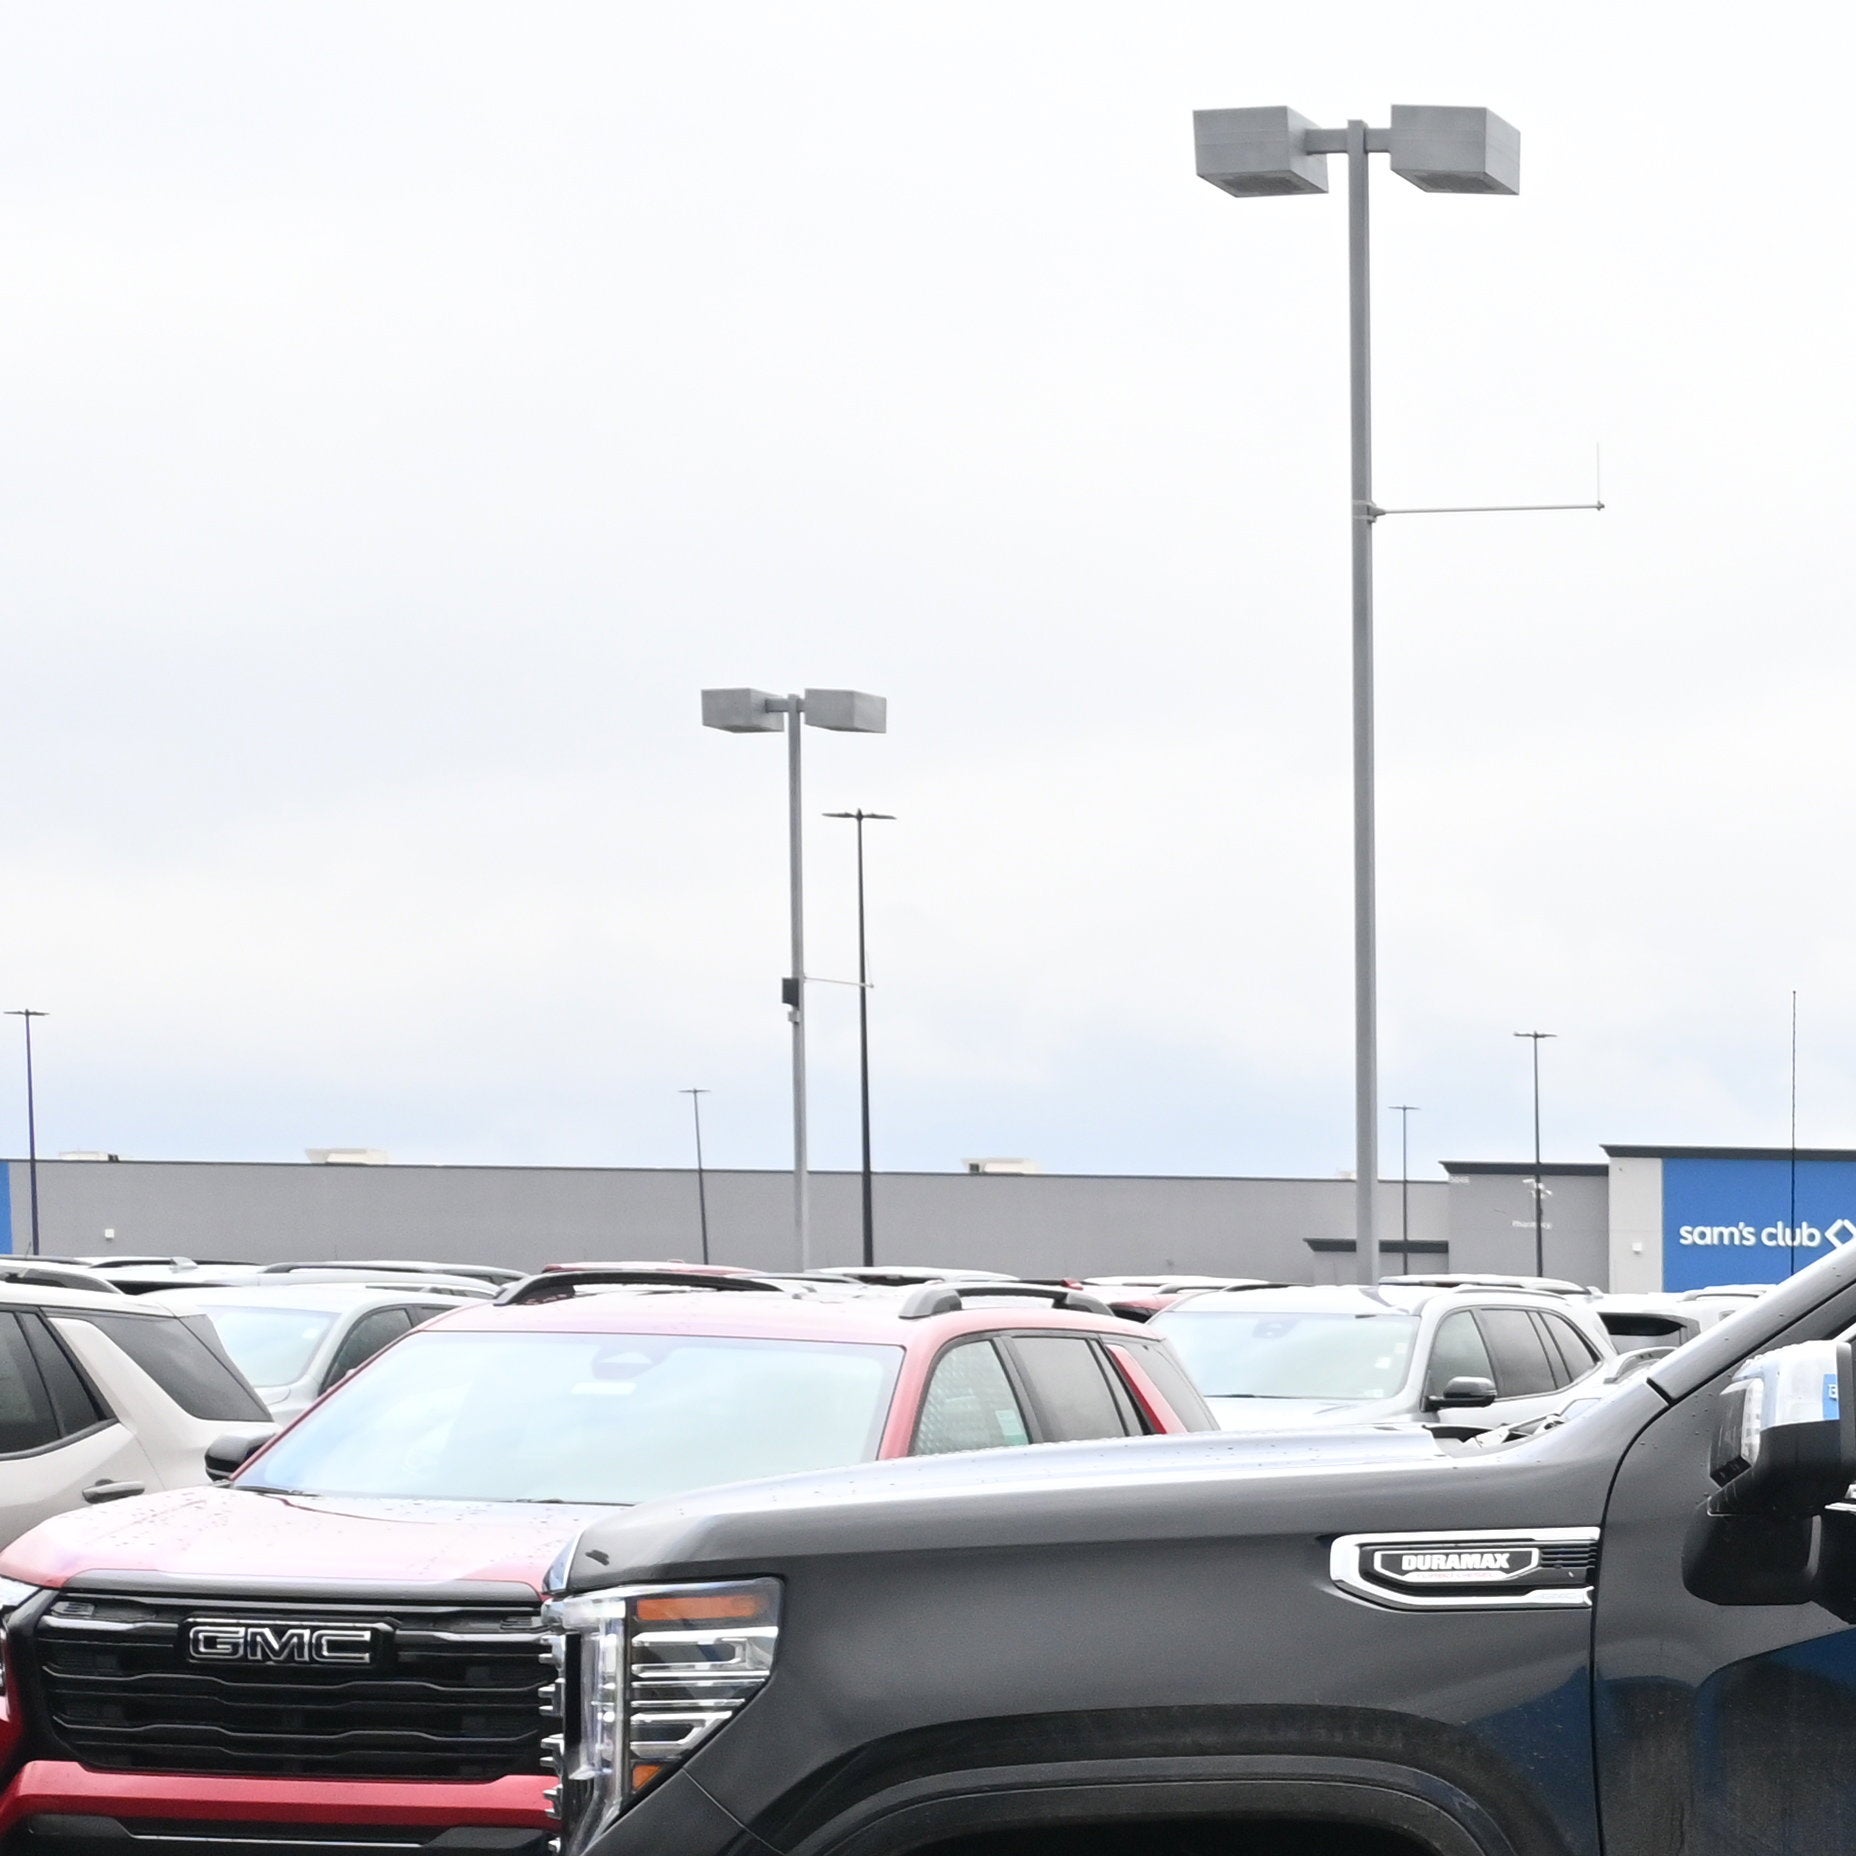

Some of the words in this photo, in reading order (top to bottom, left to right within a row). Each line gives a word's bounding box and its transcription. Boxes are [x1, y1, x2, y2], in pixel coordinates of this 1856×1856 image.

[1679, 1221, 1756, 1247] sam's
[1761, 1220, 1821, 1247] club
[1402, 1553, 1511, 1571] DURAMAX
[189, 1625, 372, 1664] GMC
